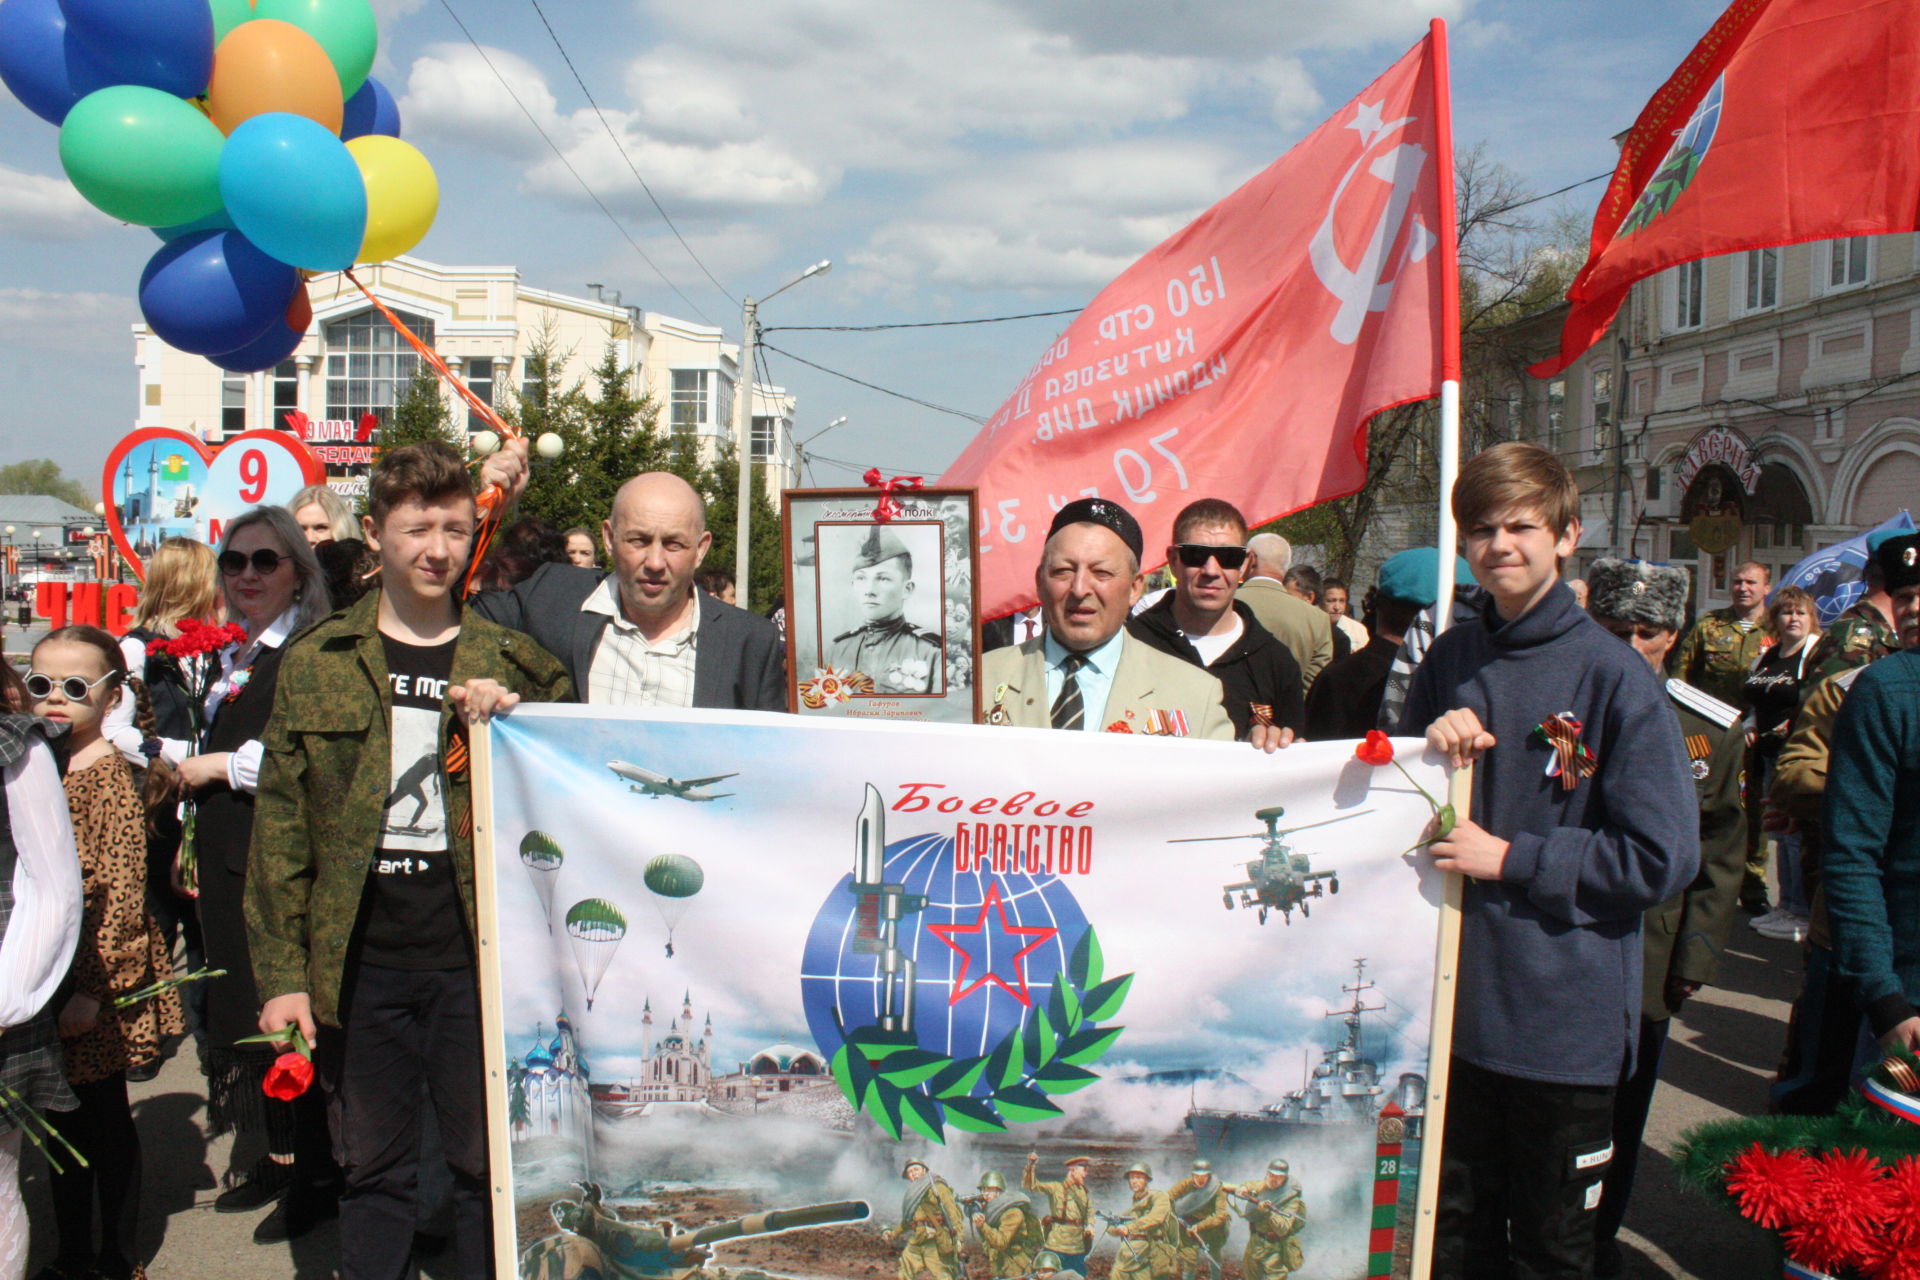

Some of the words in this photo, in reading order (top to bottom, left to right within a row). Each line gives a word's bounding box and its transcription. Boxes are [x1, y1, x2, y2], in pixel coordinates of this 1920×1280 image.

[306, 420, 316, 441] 9
[318, 420, 353, 441] МАЯ
[315, 446, 372, 467] БЕДА!
[238, 448, 268, 504] 9
[36, 581, 139, 637] ЧИС
[890, 782, 1096, 819] Боевое
[955, 822, 1094, 875] БРАТСТВО
[1380, 1160, 1396, 1176] 28
